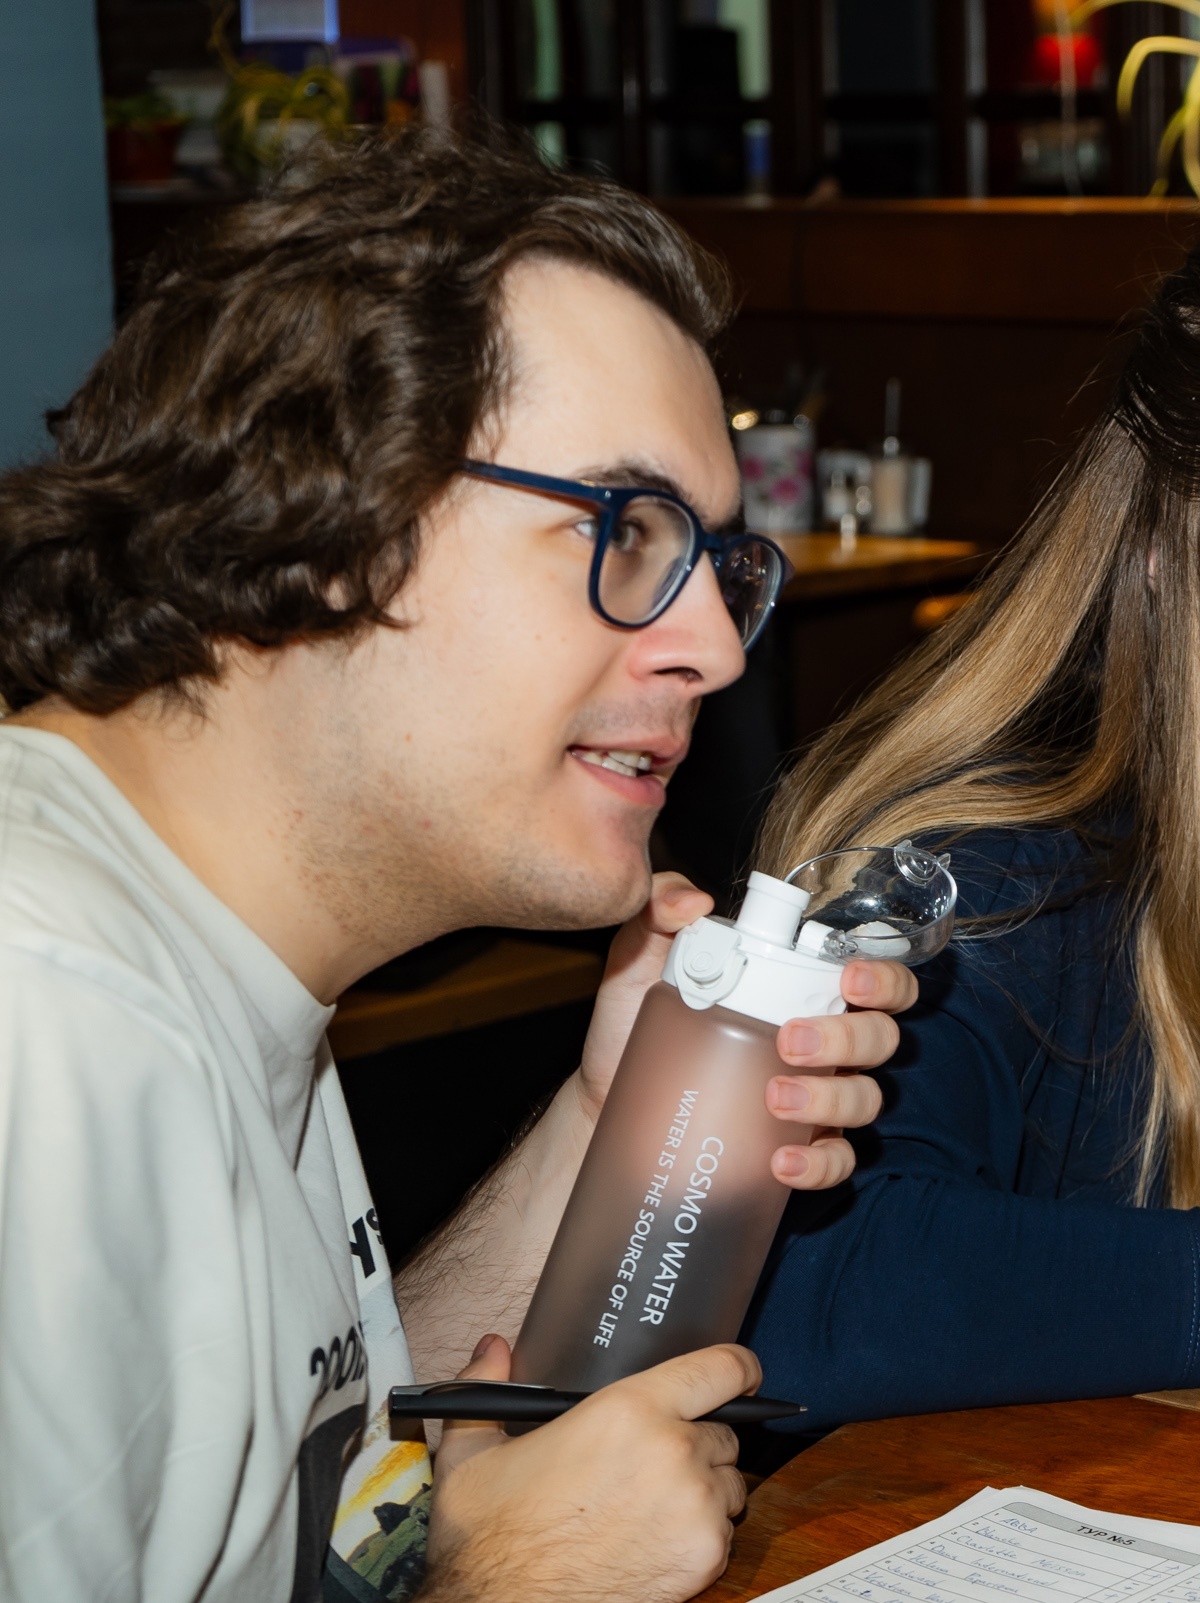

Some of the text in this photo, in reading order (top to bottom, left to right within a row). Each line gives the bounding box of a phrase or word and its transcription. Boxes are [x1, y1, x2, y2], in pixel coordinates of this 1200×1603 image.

[593, 1089, 700, 1349] WATER IS THE SOURCE OF LIFE
[639, 1136, 724, 1326] COSMO WATER
[1001, 1518, 1038, 1534] ABBA
[1076, 1525, 1107, 1538] ТУР
